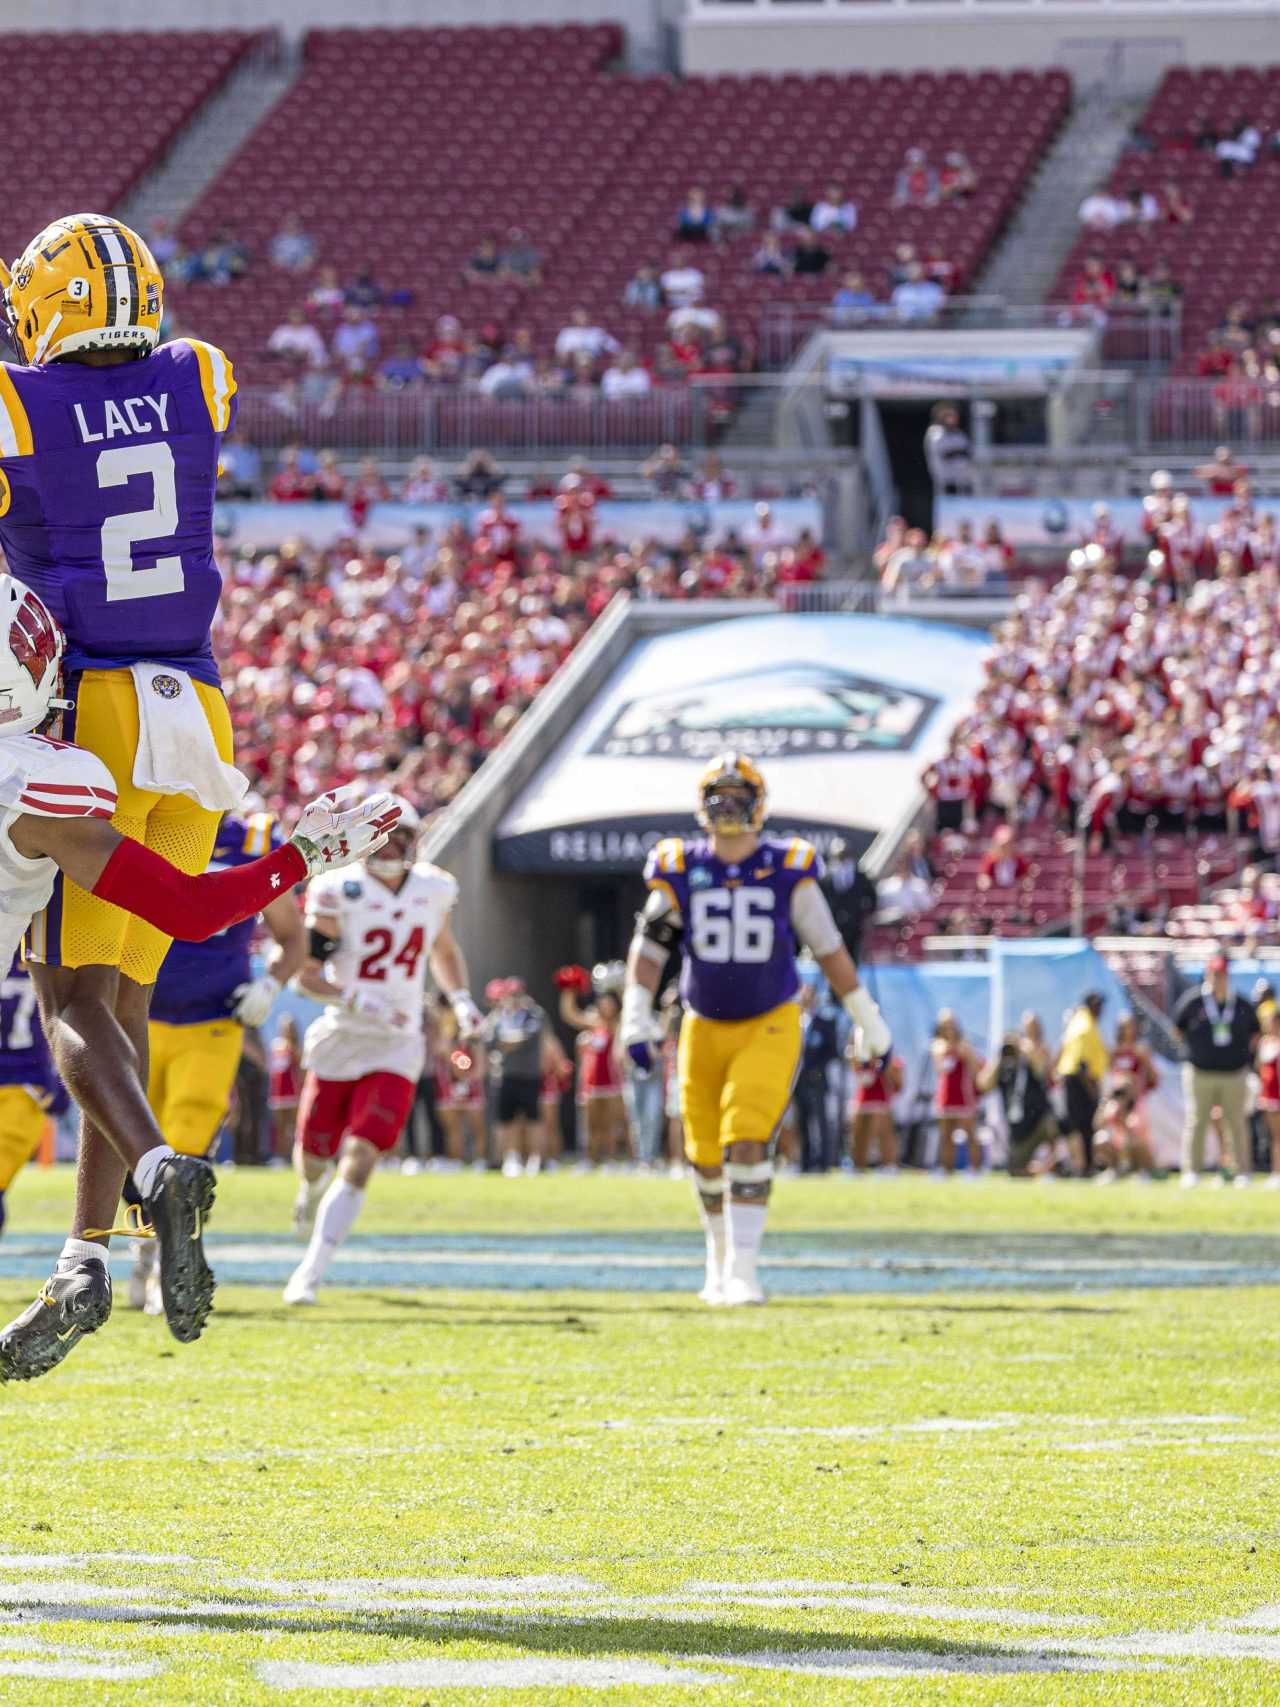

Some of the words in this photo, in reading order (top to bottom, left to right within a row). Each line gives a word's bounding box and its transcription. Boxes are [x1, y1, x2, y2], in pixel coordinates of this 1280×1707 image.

[74, 281, 83, 296] 3
[99, 330, 146, 341] TIGERS
[74, 393, 169, 443] LACY
[96, 441, 185, 602] 2
[690, 886, 775, 963] 66
[358, 925, 425, 981] 24
